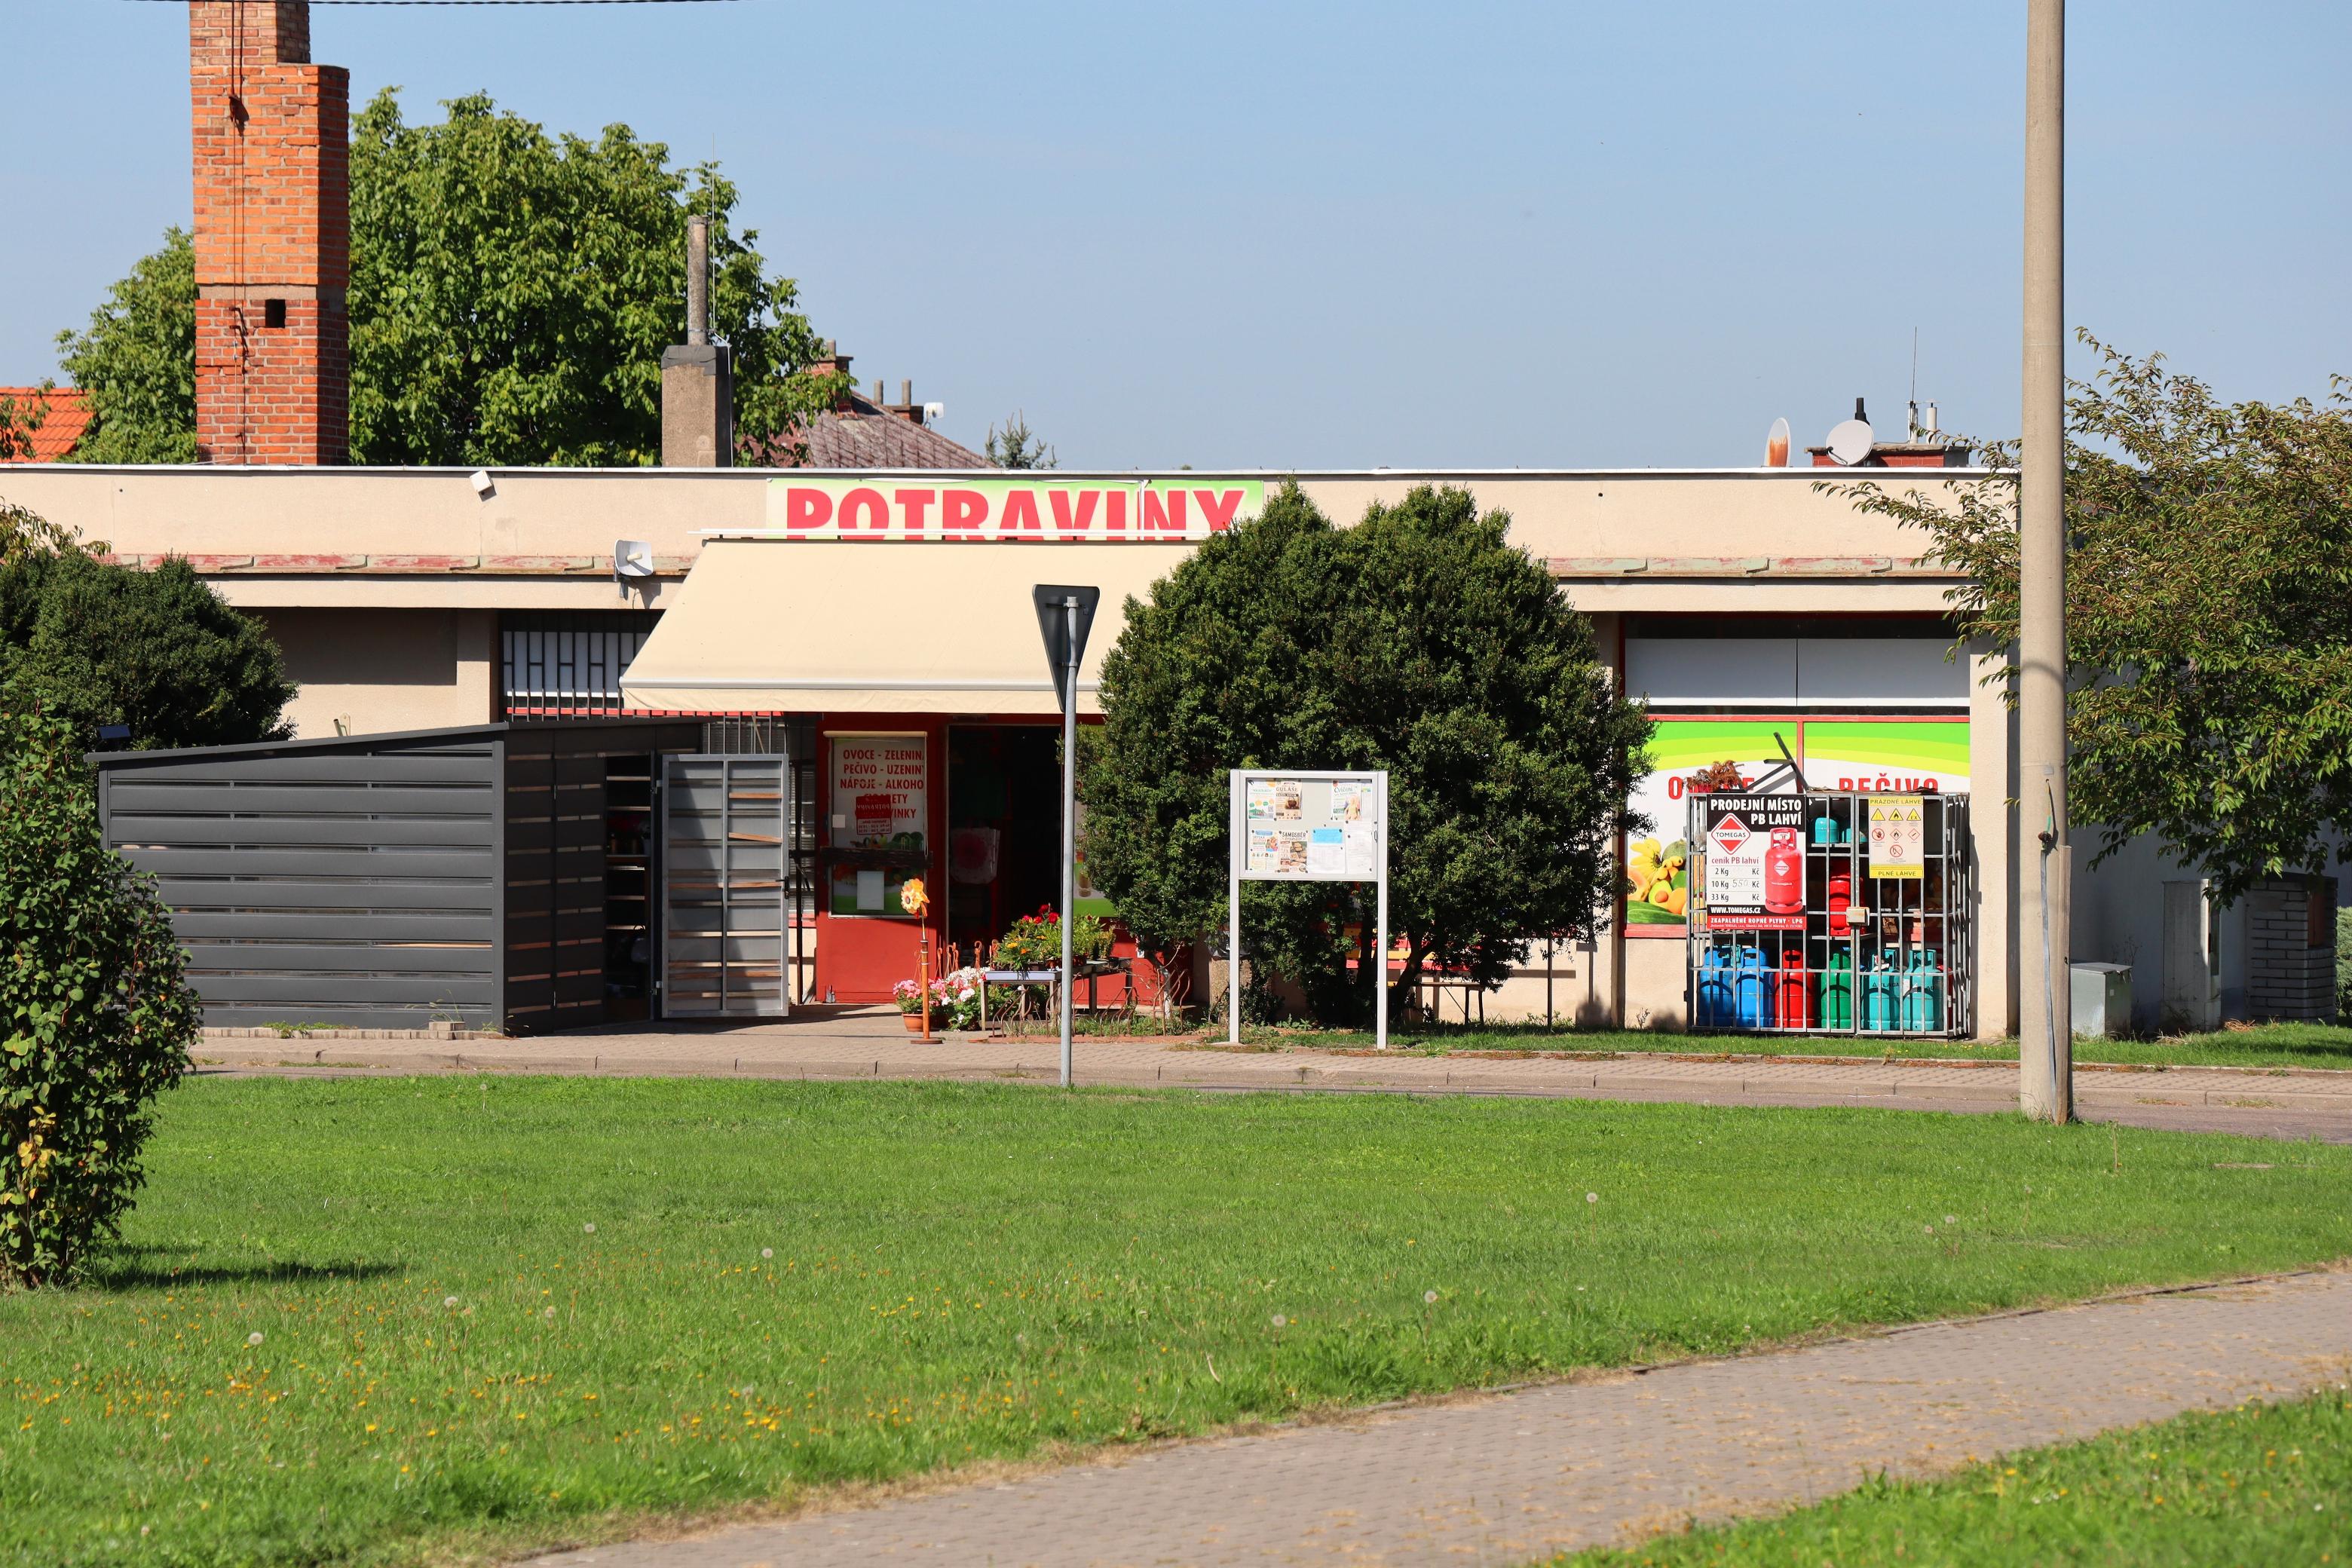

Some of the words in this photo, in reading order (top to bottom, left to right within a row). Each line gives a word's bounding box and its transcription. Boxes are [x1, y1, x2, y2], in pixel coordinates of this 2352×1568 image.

[786, 488, 1245, 541] POTRAVINY
[843, 749, 875, 760] OVOCE
[884, 750, 924, 761] ZELENIN
[844, 762, 877, 774] PEČIVO
[887, 764, 924, 775] UZENIN
[840, 776, 875, 789] NÁPOJE
[1839, 773, 1939, 792] PEČIVO
[1710, 797, 1765, 811] PRODEJNÍ
[1767, 797, 1802, 811] MÍSTO
[1750, 813, 1766, 825] PB
[1769, 811, 1802, 825] LAHVÍ
[1720, 880, 1729, 889] Kg
